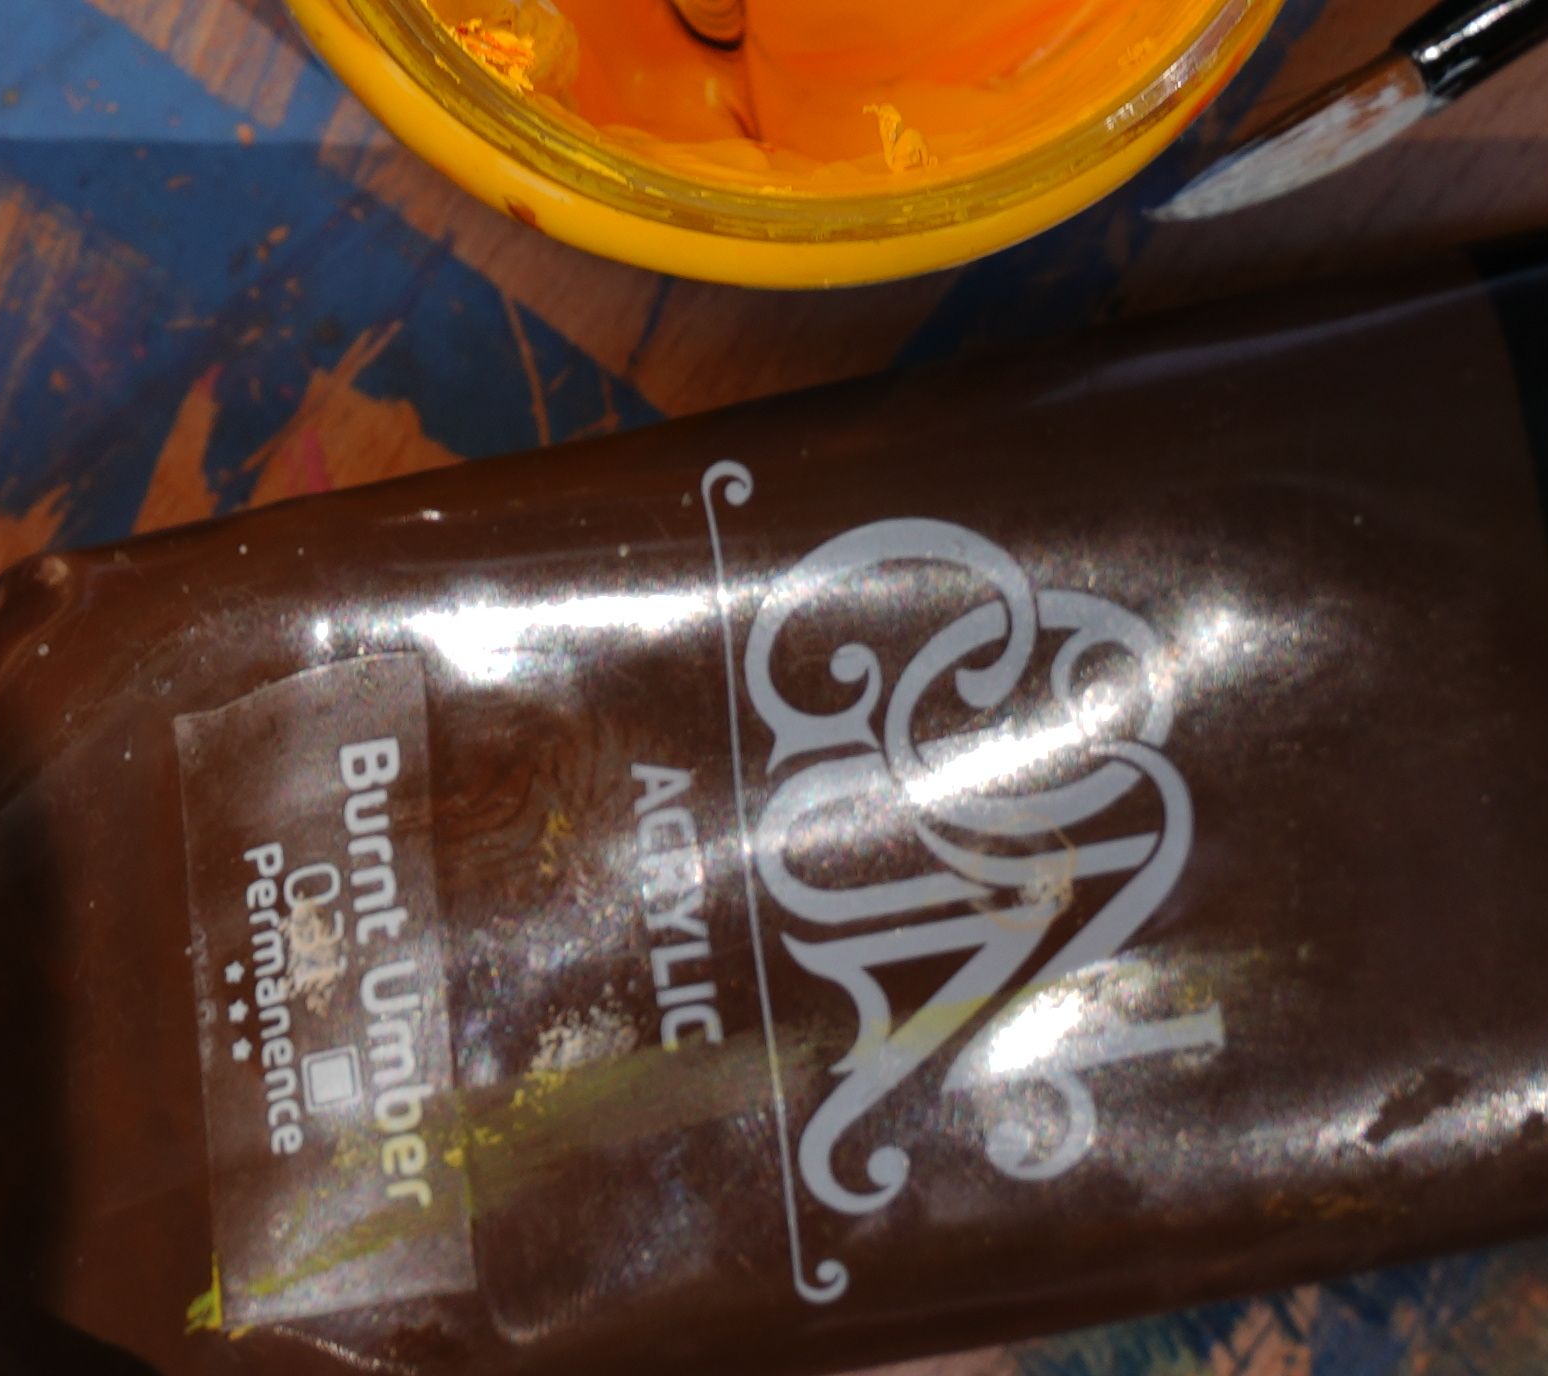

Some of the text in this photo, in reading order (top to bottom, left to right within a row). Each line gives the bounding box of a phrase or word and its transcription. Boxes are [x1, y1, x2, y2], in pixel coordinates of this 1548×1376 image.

[242, 841, 304, 1156] Permanence
[337, 736, 433, 1210] Burnt Umber
[630, 761, 724, 1052] ACRYLIC
